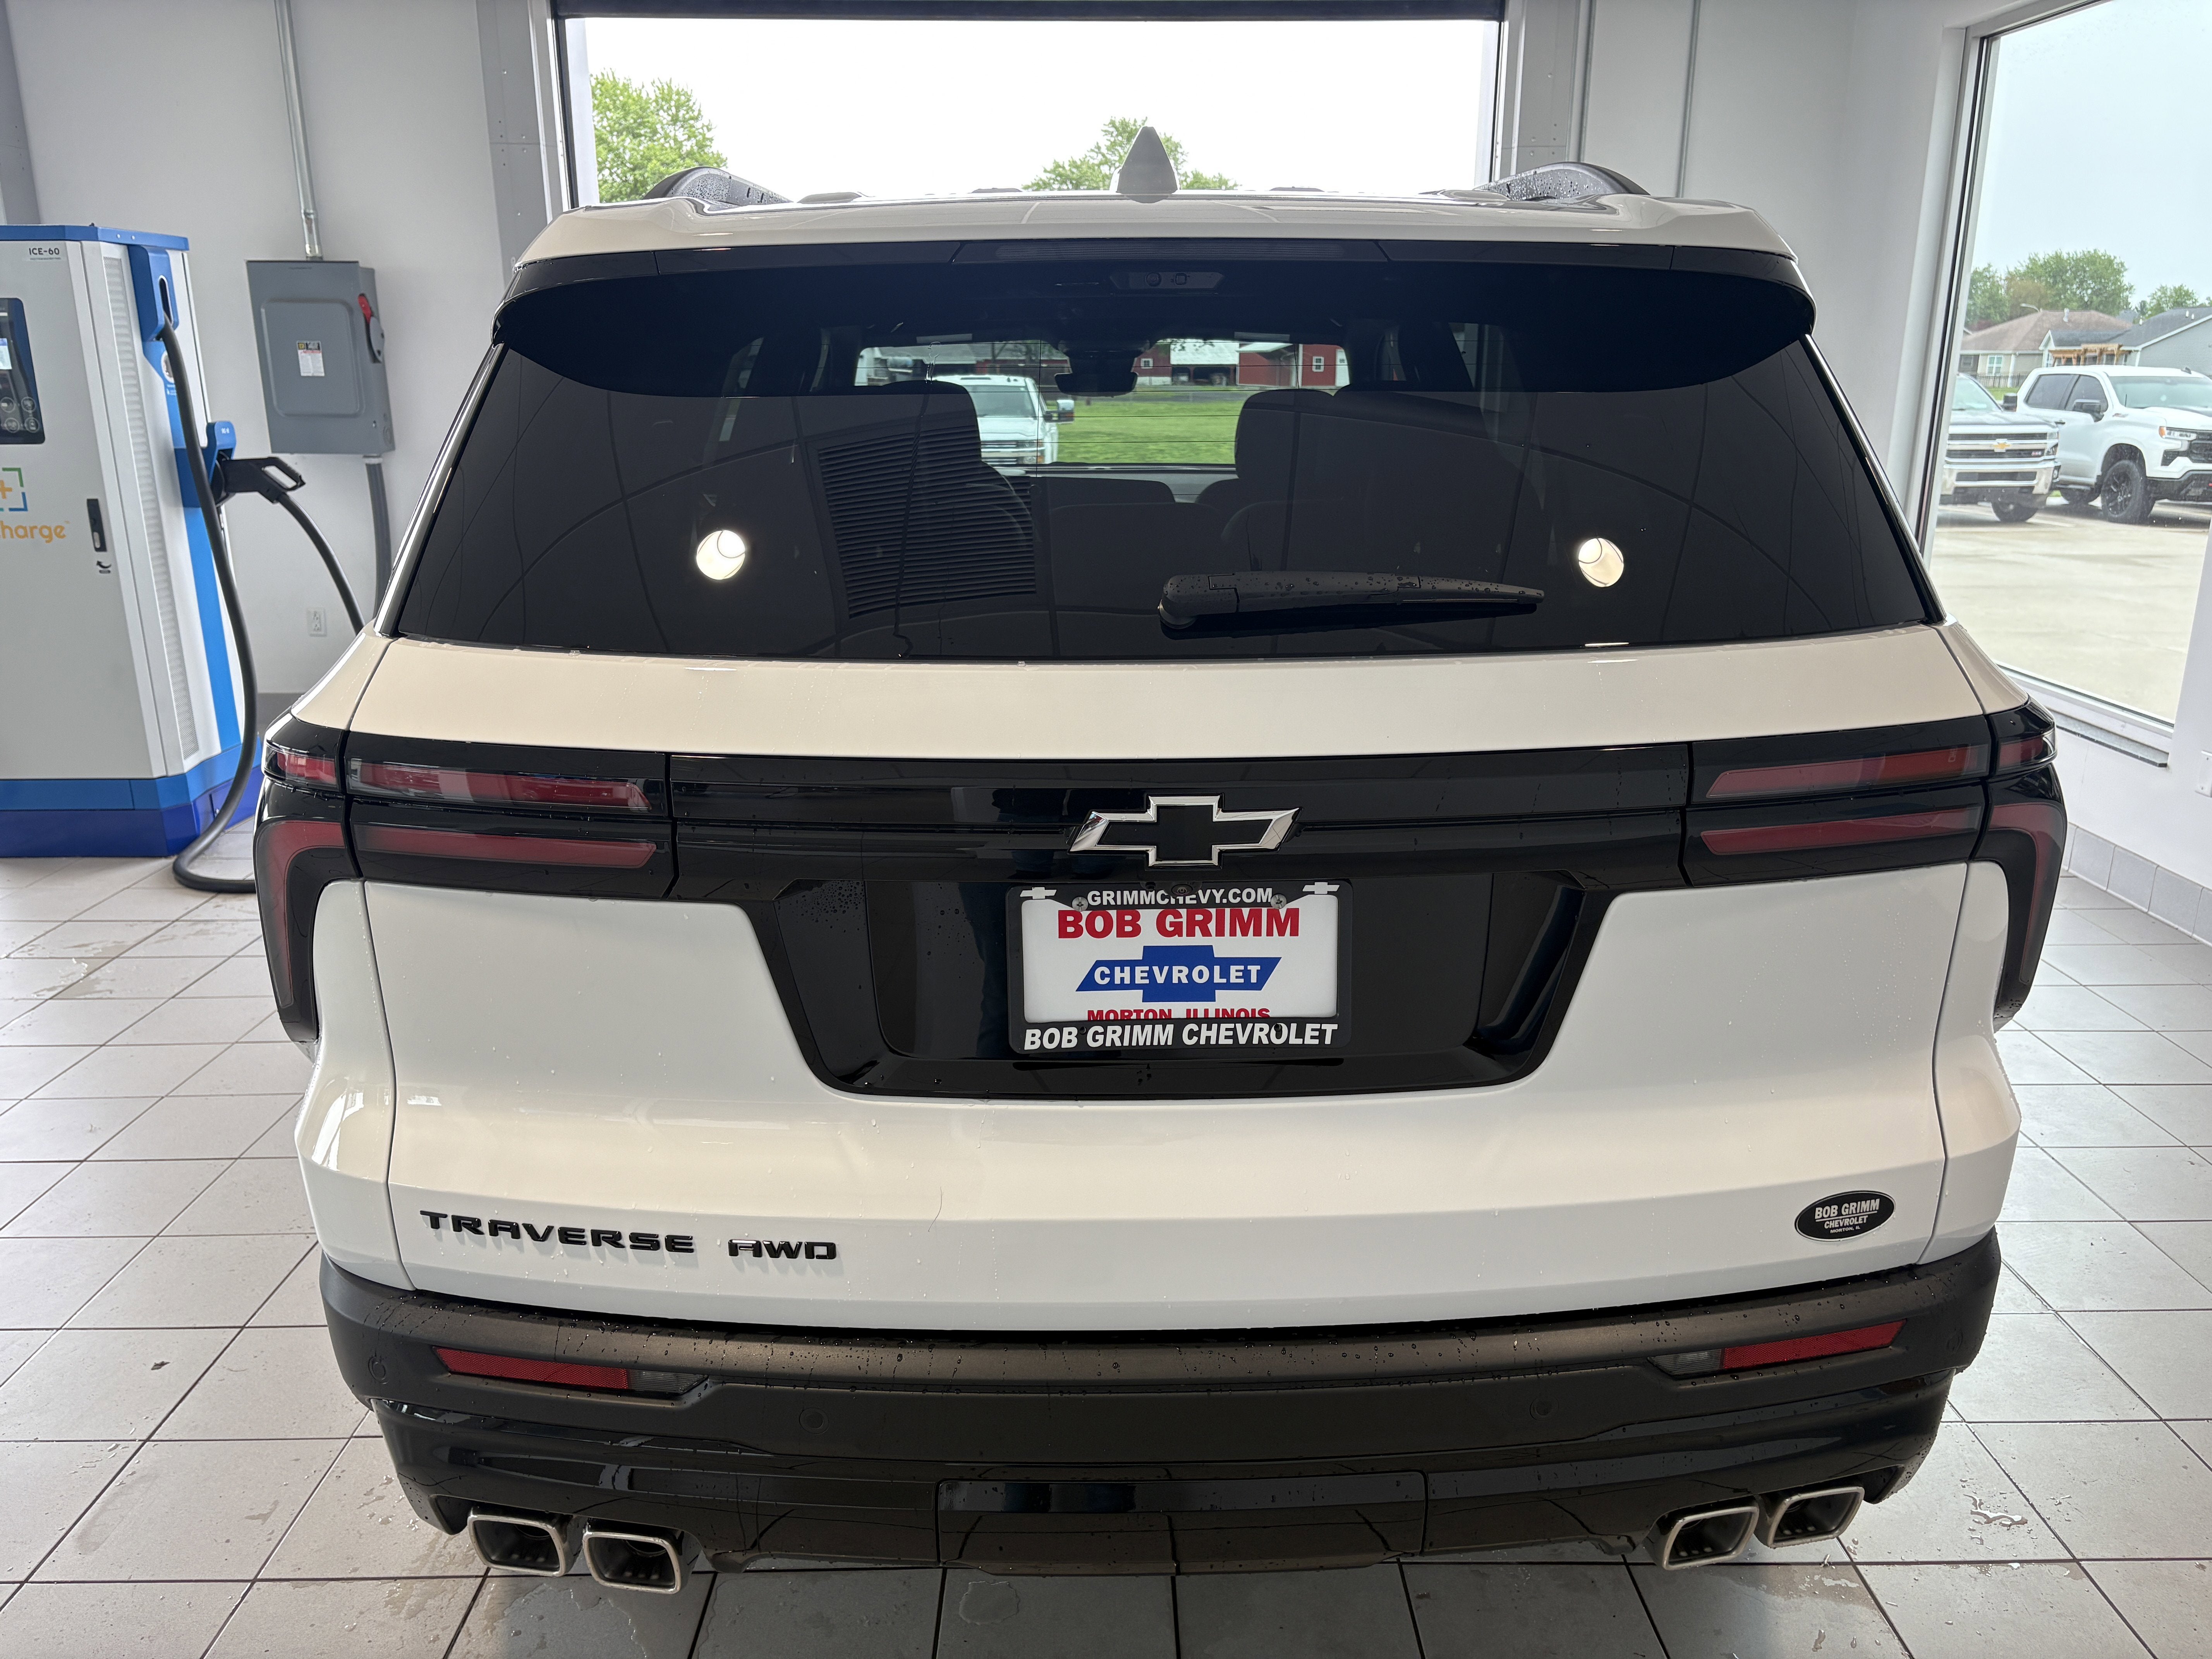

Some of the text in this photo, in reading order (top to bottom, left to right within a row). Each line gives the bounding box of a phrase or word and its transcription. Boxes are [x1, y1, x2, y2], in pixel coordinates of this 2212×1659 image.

[0, 520, 67, 543] harge
[1058, 908, 1300, 939] BOB GRIMM
[1094, 965, 1262, 985] CHEVROLET
[1087, 1008, 1172, 1021] MORTON
[1024, 1023, 1338, 1050] BOB GRIMM CHEVROLET
[1815, 1199, 1880, 1219] BOB GRIMM
[1824, 1215, 1869, 1229] CHEVROLET
[419, 1210, 837, 1260] TRAVERSE AWD
